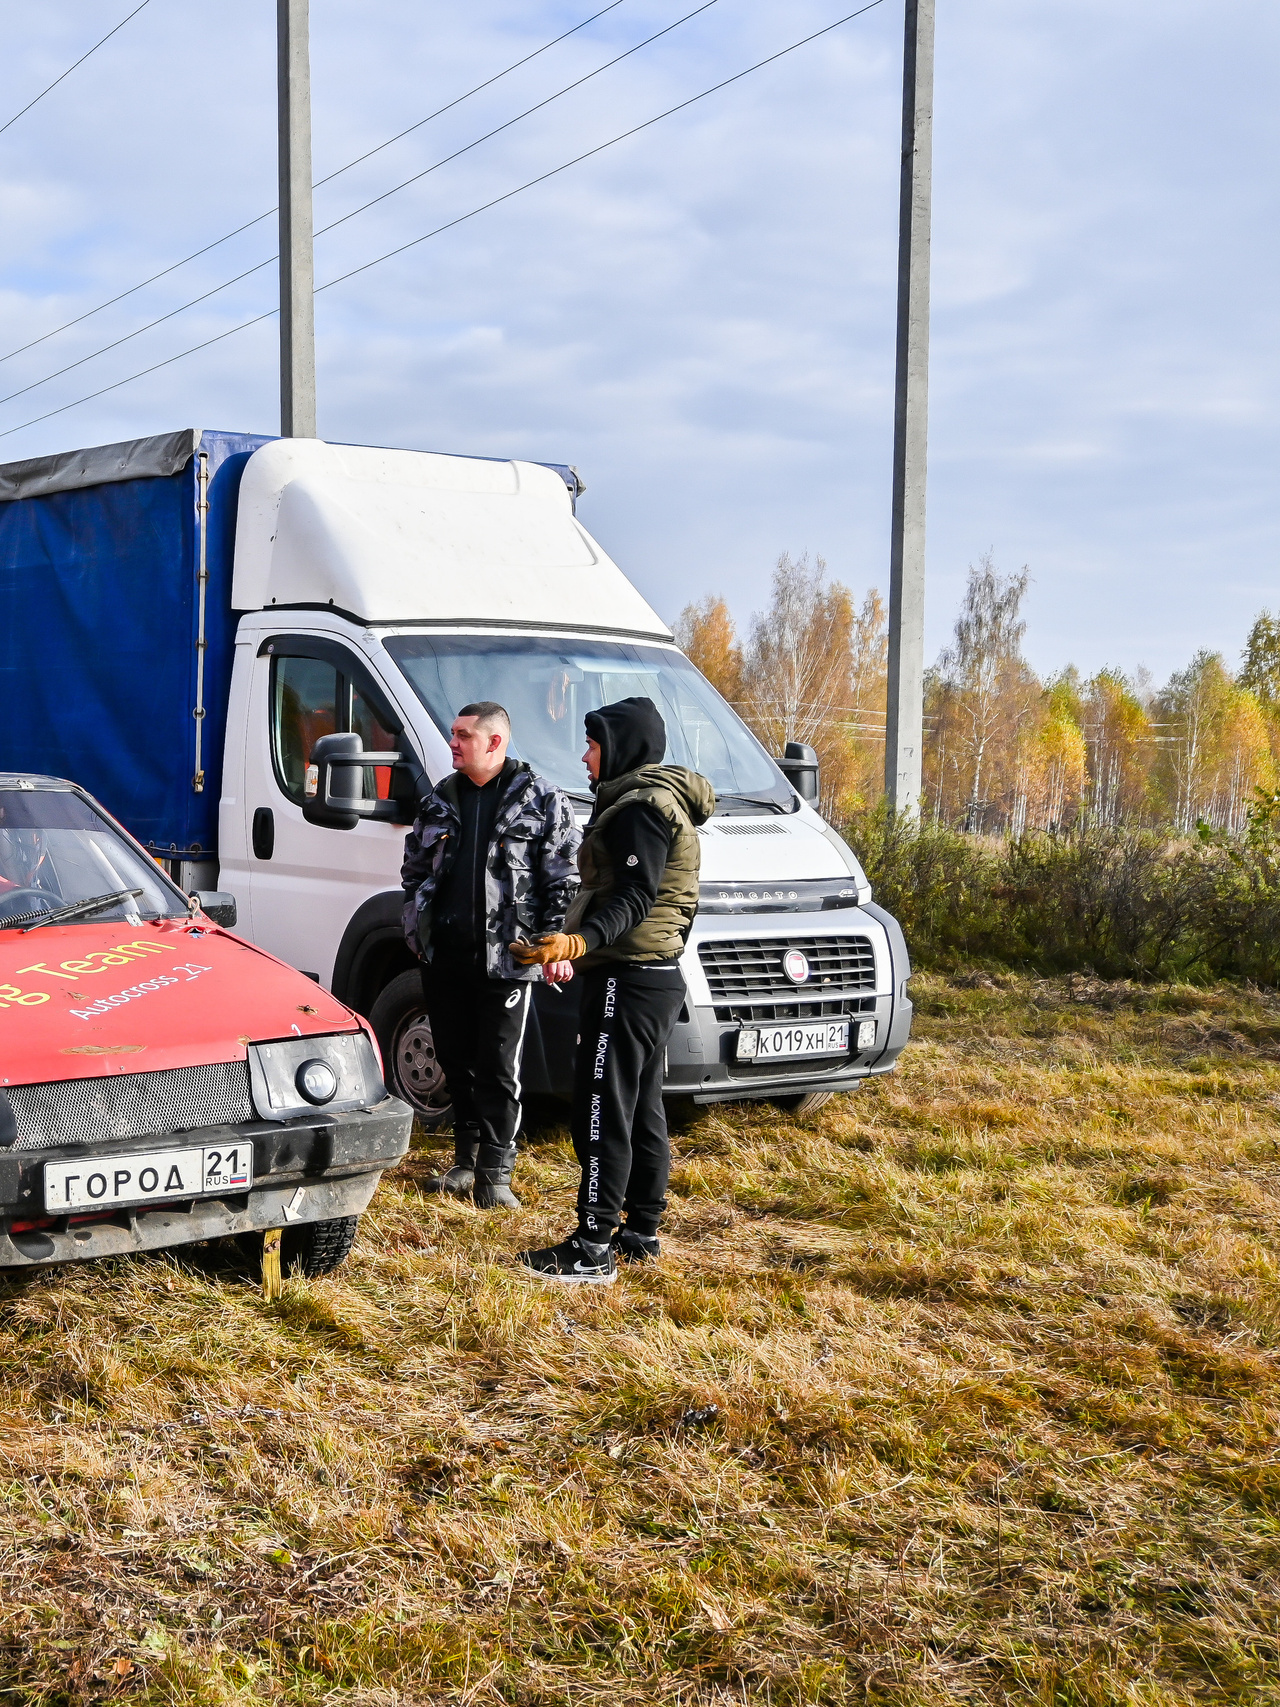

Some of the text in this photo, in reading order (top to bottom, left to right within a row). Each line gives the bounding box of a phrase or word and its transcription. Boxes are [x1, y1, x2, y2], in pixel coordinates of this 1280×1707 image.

[719, 891, 798, 900] DUCATO
[17, 939, 176, 980] Team
[829, 1025, 844, 1042] 21
[593, 1032, 609, 1080] MONCLER
[590, 1093, 601, 1142] MONCLER
[205, 1175, 229, 1187] RUS
[207, 1149, 239, 1177] 21
[588, 1155, 599, 1203] MONCLER
[65, 1164, 184, 1202] ГОРОД
